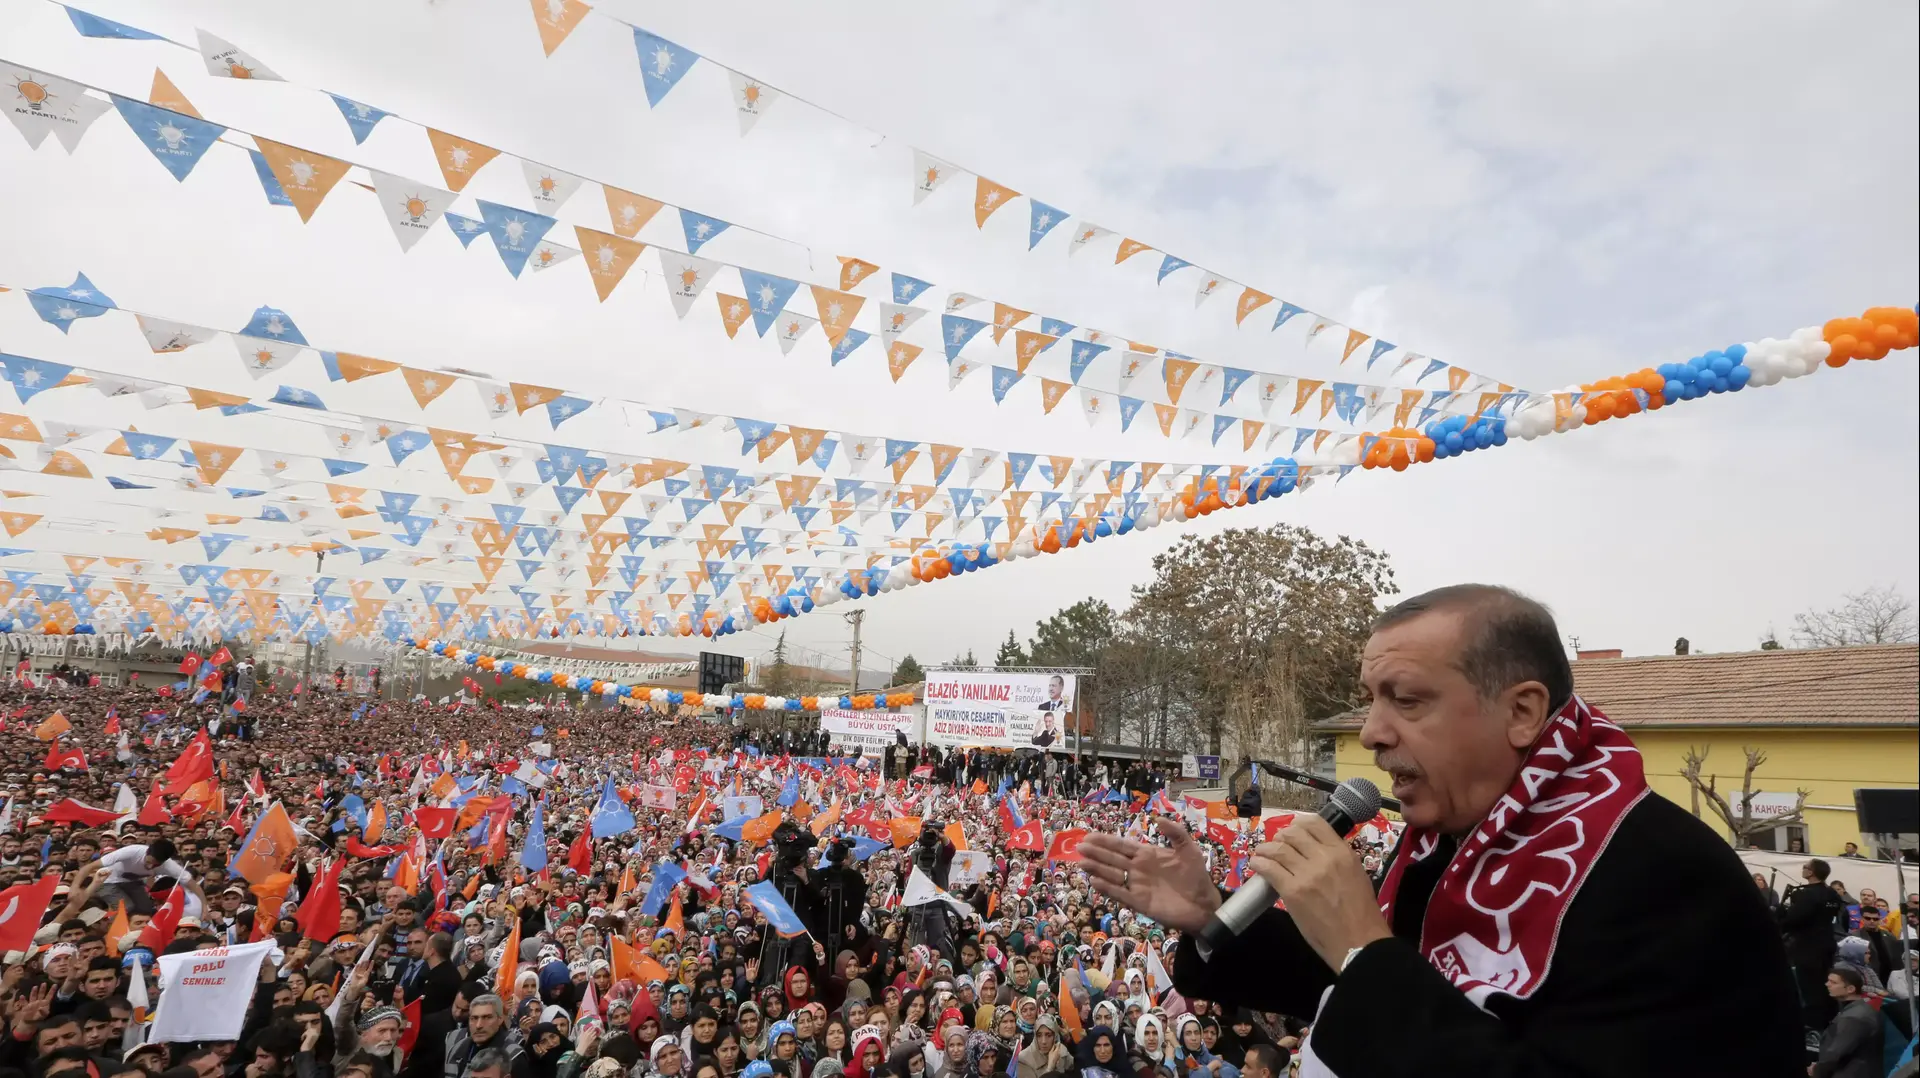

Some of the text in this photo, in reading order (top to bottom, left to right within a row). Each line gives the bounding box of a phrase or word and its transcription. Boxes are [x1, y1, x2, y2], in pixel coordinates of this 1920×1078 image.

[927, 680, 1011, 701] ELAZIĞ YANILMAZ
[877, 723, 896, 731] USTA
[192, 960, 226, 974] PALU
